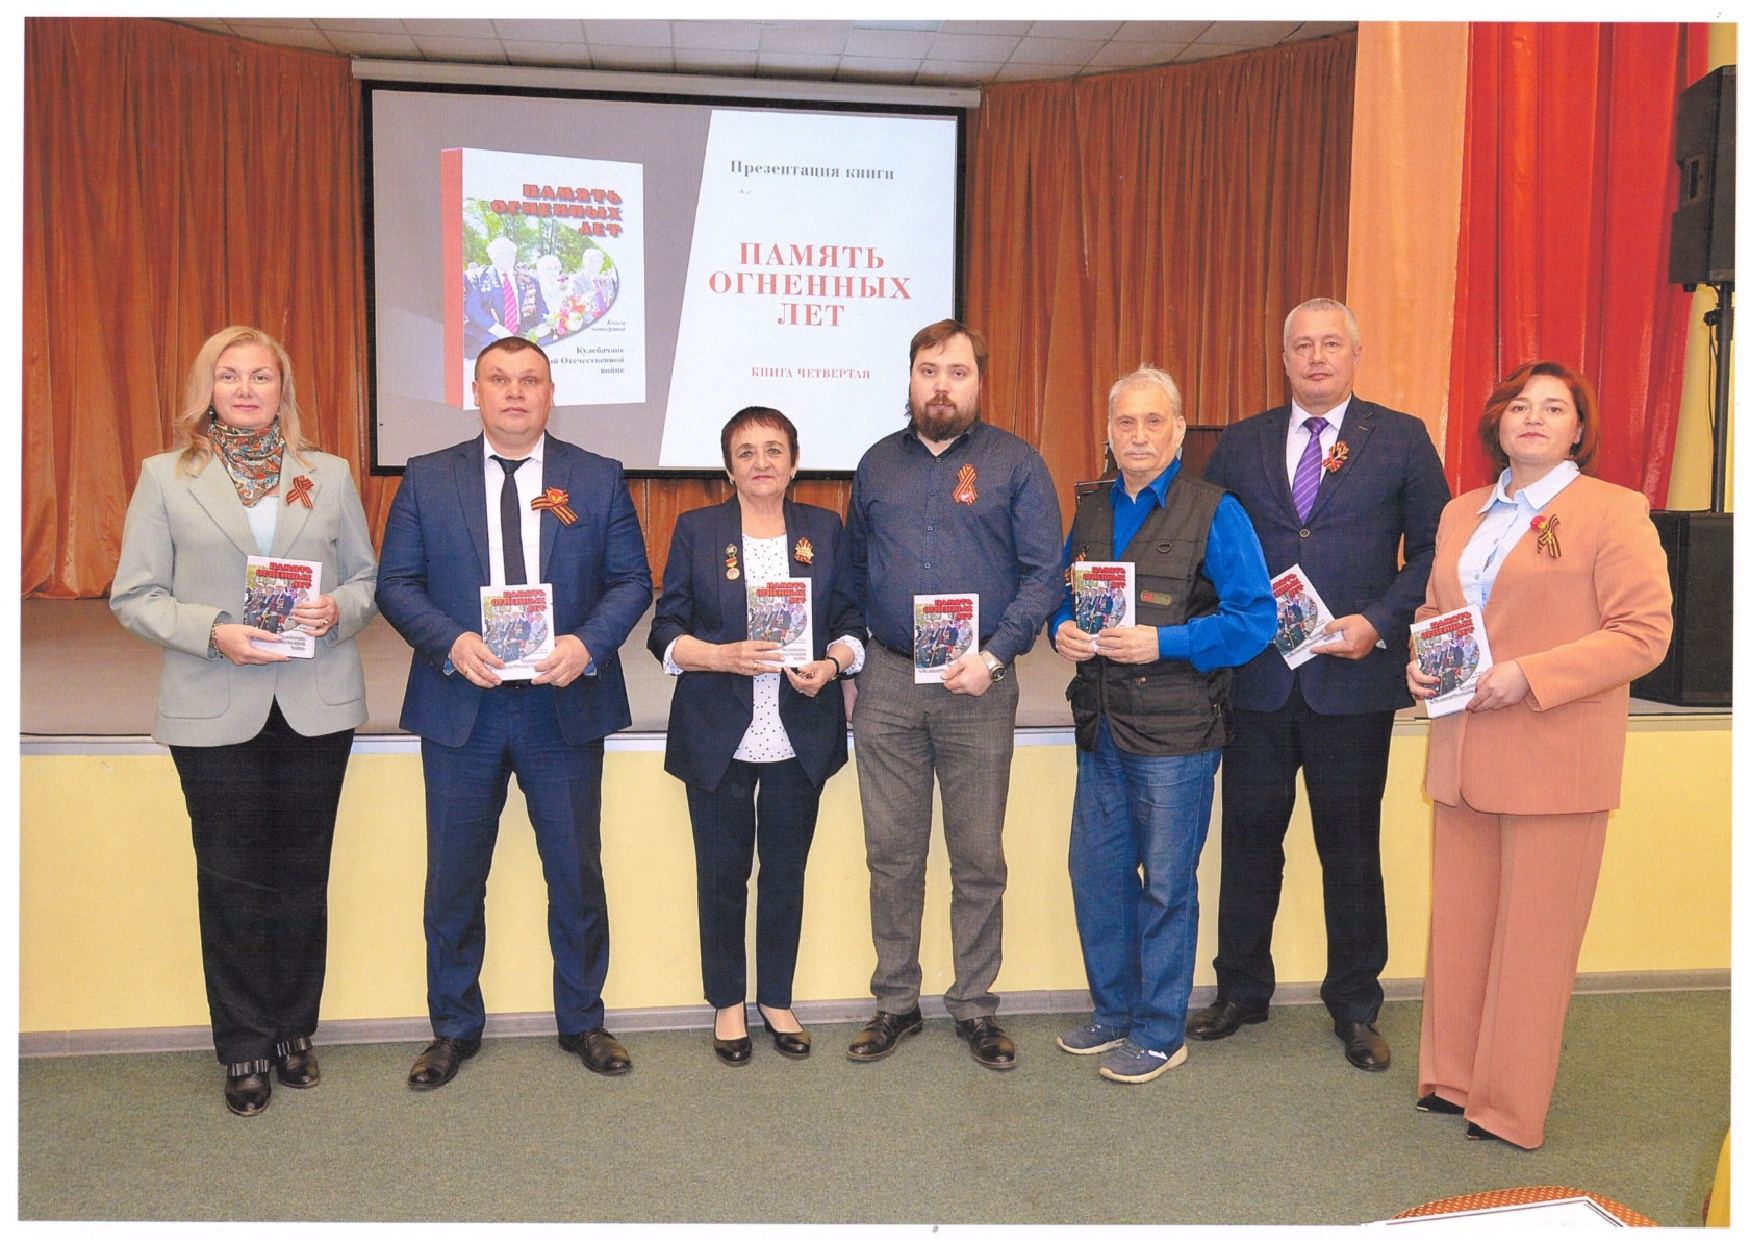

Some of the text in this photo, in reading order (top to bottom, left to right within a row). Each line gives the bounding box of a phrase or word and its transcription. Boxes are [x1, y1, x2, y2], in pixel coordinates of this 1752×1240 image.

[731, 160, 895, 180] Презентация книги
[523, 184, 623, 204] ПАМЯТЬ
[490, 200, 623, 221] ОГНЕННЫХ
[578, 221, 623, 238] ЛЕТ
[739, 242, 885, 269] ПАМЯТЬ
[708, 271, 912, 300] ОГНЕННЫХ
[777, 303, 845, 327] ЛЕТ
[560, 357, 625, 365] Отечественной
[751, 367, 871, 380] КНИГА ЧЕТВЕРТАЯ
